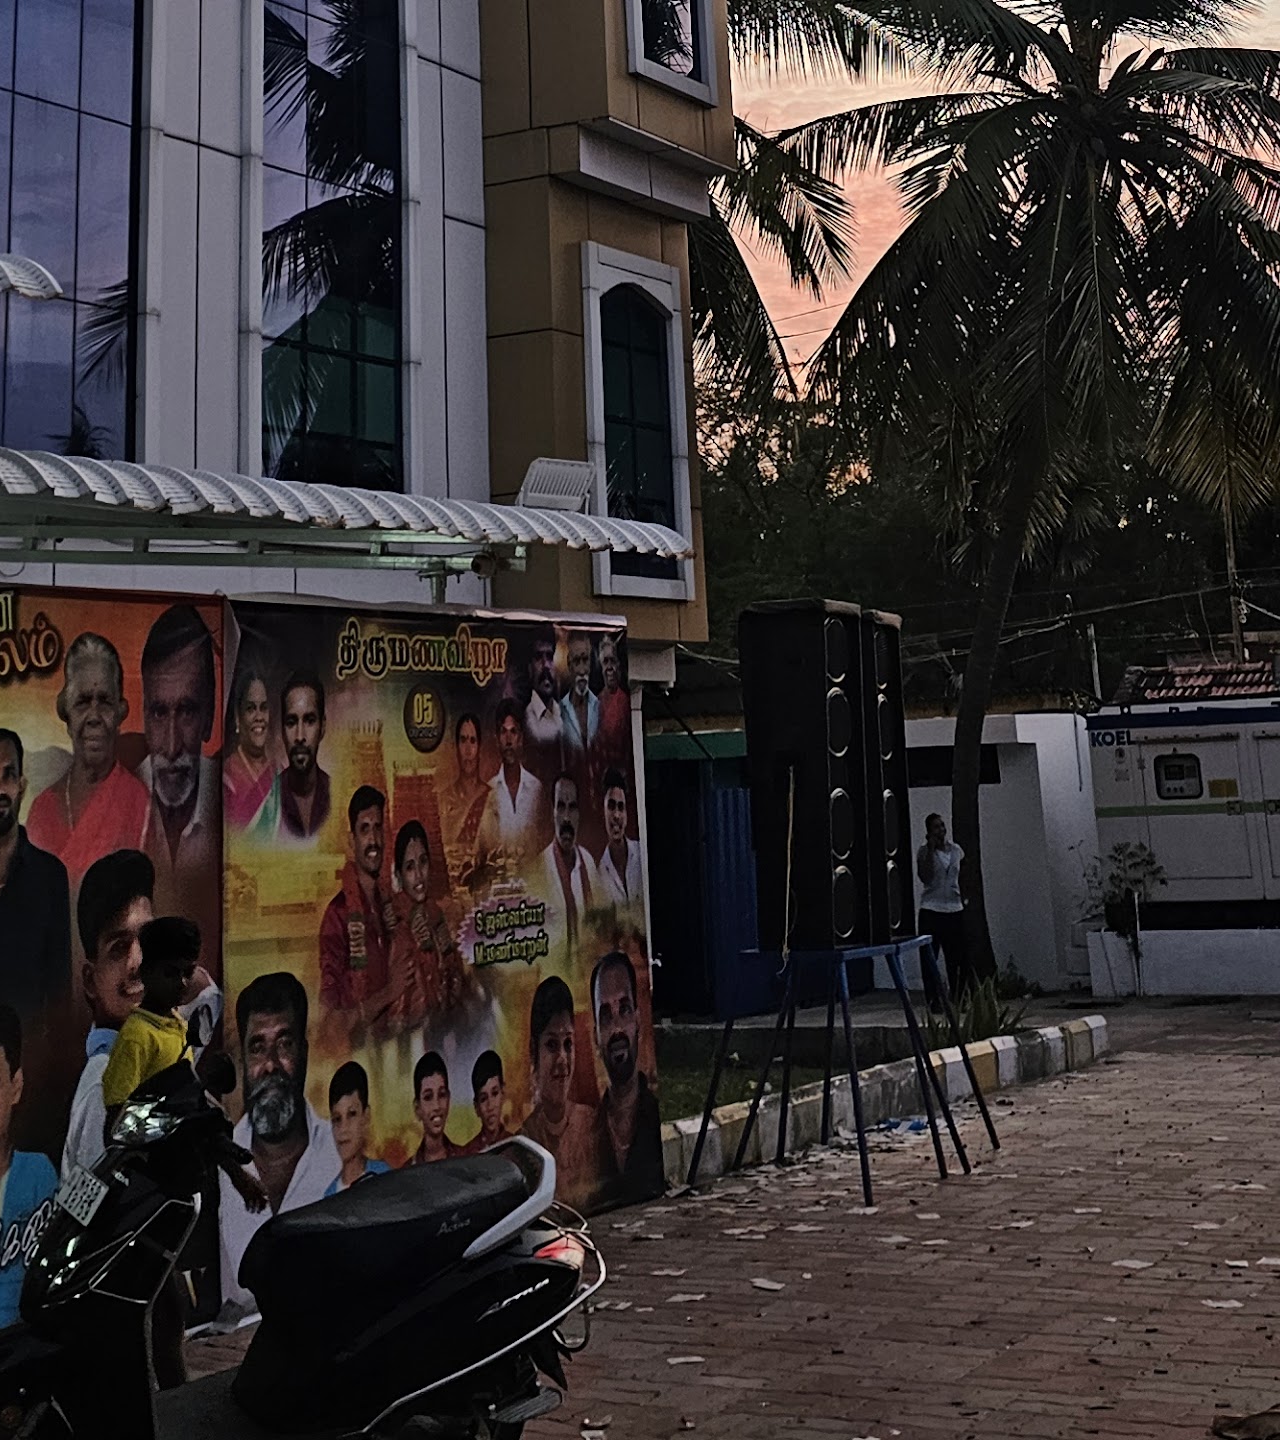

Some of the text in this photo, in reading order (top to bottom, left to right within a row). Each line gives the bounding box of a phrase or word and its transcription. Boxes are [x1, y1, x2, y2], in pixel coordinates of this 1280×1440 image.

[336, 616, 508, 687] திருமணவிழா
[412, 692, 434, 726] 05
[1091, 731, 1136, 747] KOEL
